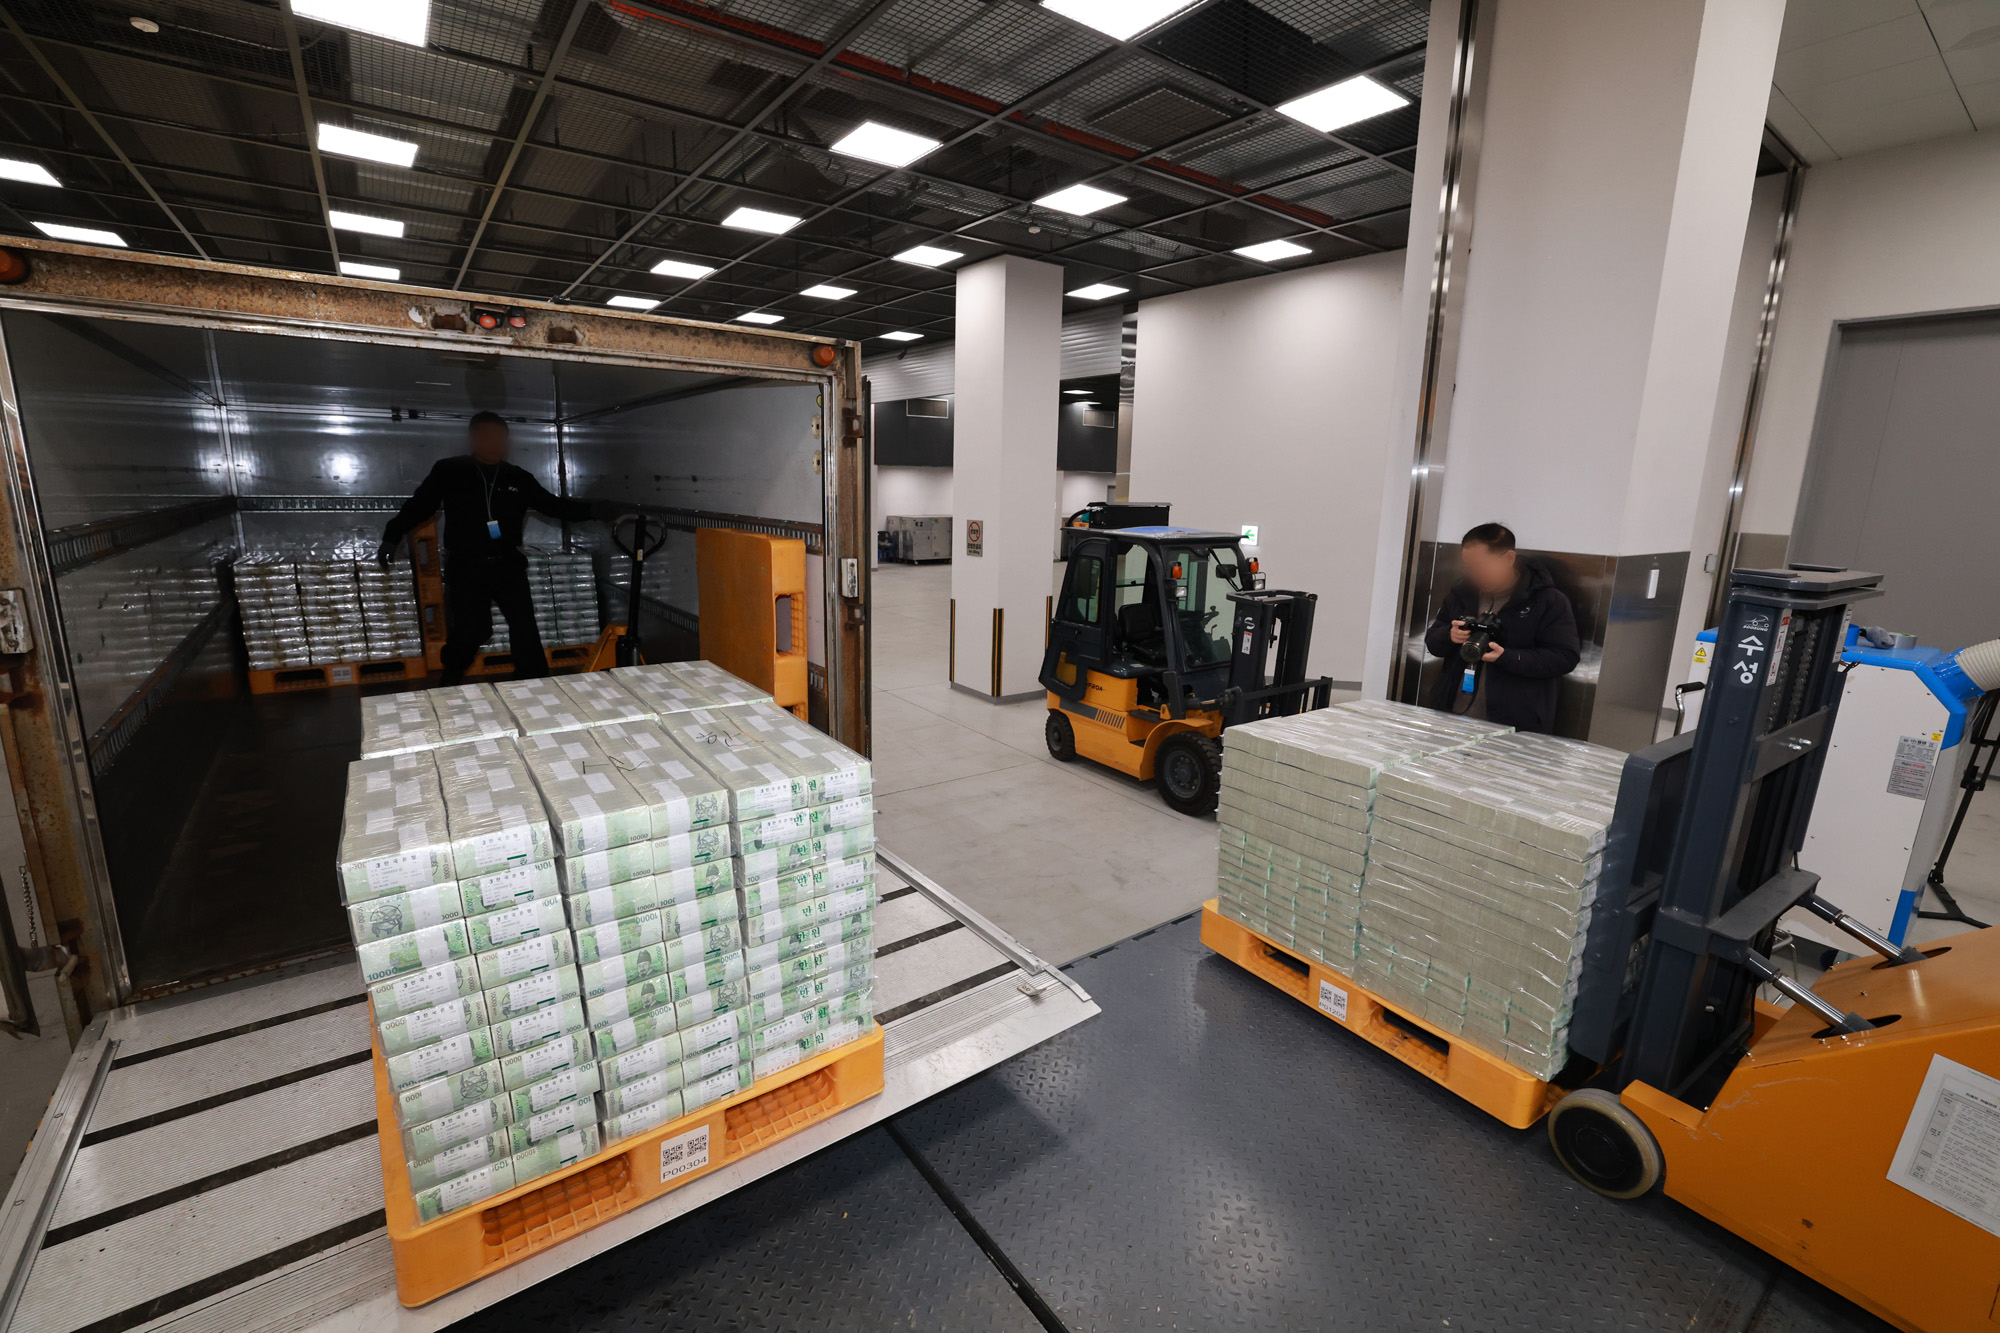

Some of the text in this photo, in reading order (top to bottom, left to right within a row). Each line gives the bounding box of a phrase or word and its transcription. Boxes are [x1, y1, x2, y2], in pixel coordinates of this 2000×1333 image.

[630, 833, 649, 841] 10000
[633, 869, 651, 877] 10000
[637, 903, 655, 912] 10000
[636, 912, 658, 924] 10000
[367, 967, 399, 981] 10000
[589, 987, 606, 996] 1000
[679, 999, 692, 1007] 0000
[504, 1056, 522, 1066] 0000
[492, 1160, 509, 1172] 100
[663, 1156, 706, 1179] P00304
